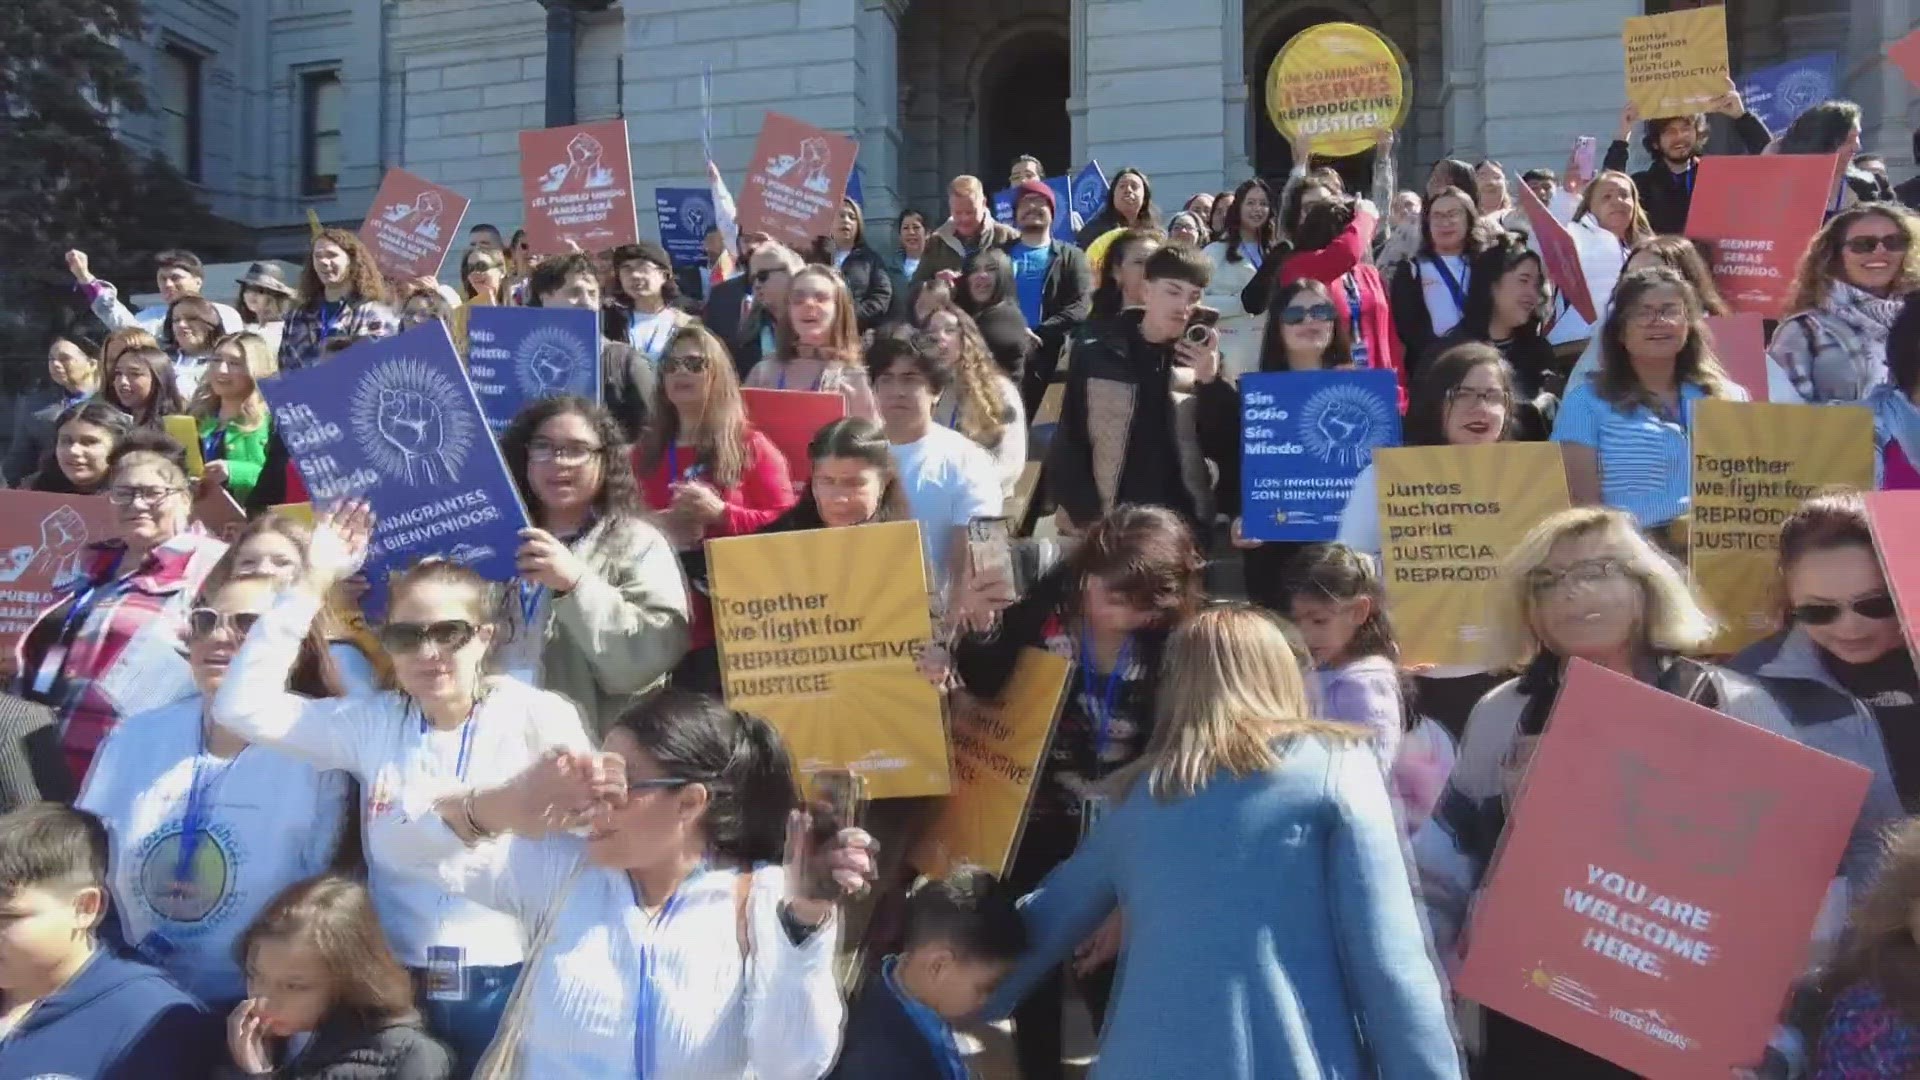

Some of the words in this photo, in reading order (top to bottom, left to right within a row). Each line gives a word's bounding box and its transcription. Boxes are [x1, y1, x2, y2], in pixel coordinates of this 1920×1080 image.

[1244, 392, 1274, 405] Sin
[1244, 408, 1289, 421] Odio
[1244, 425, 1274, 438] Sin
[1244, 442, 1304, 455] Miedo
[299, 452, 339, 476] Sin
[1695, 454, 1791, 478] Together
[1695, 481, 1724, 496] we
[1728, 478, 1778, 503] fight
[1387, 500, 1501, 517] luchamos
[1393, 544, 1497, 562] JUSTICIA
[719, 592, 829, 620] Together
[761, 615, 819, 643] fight
[823, 613, 864, 635] for
[728, 638, 925, 672] REPRODUCTIVE
[731, 672, 833, 697] JUSTICE
[1587, 863, 1648, 904] YOU
[1648, 895, 1713, 931] ARE
[1563, 886, 1714, 966] WELCOME
